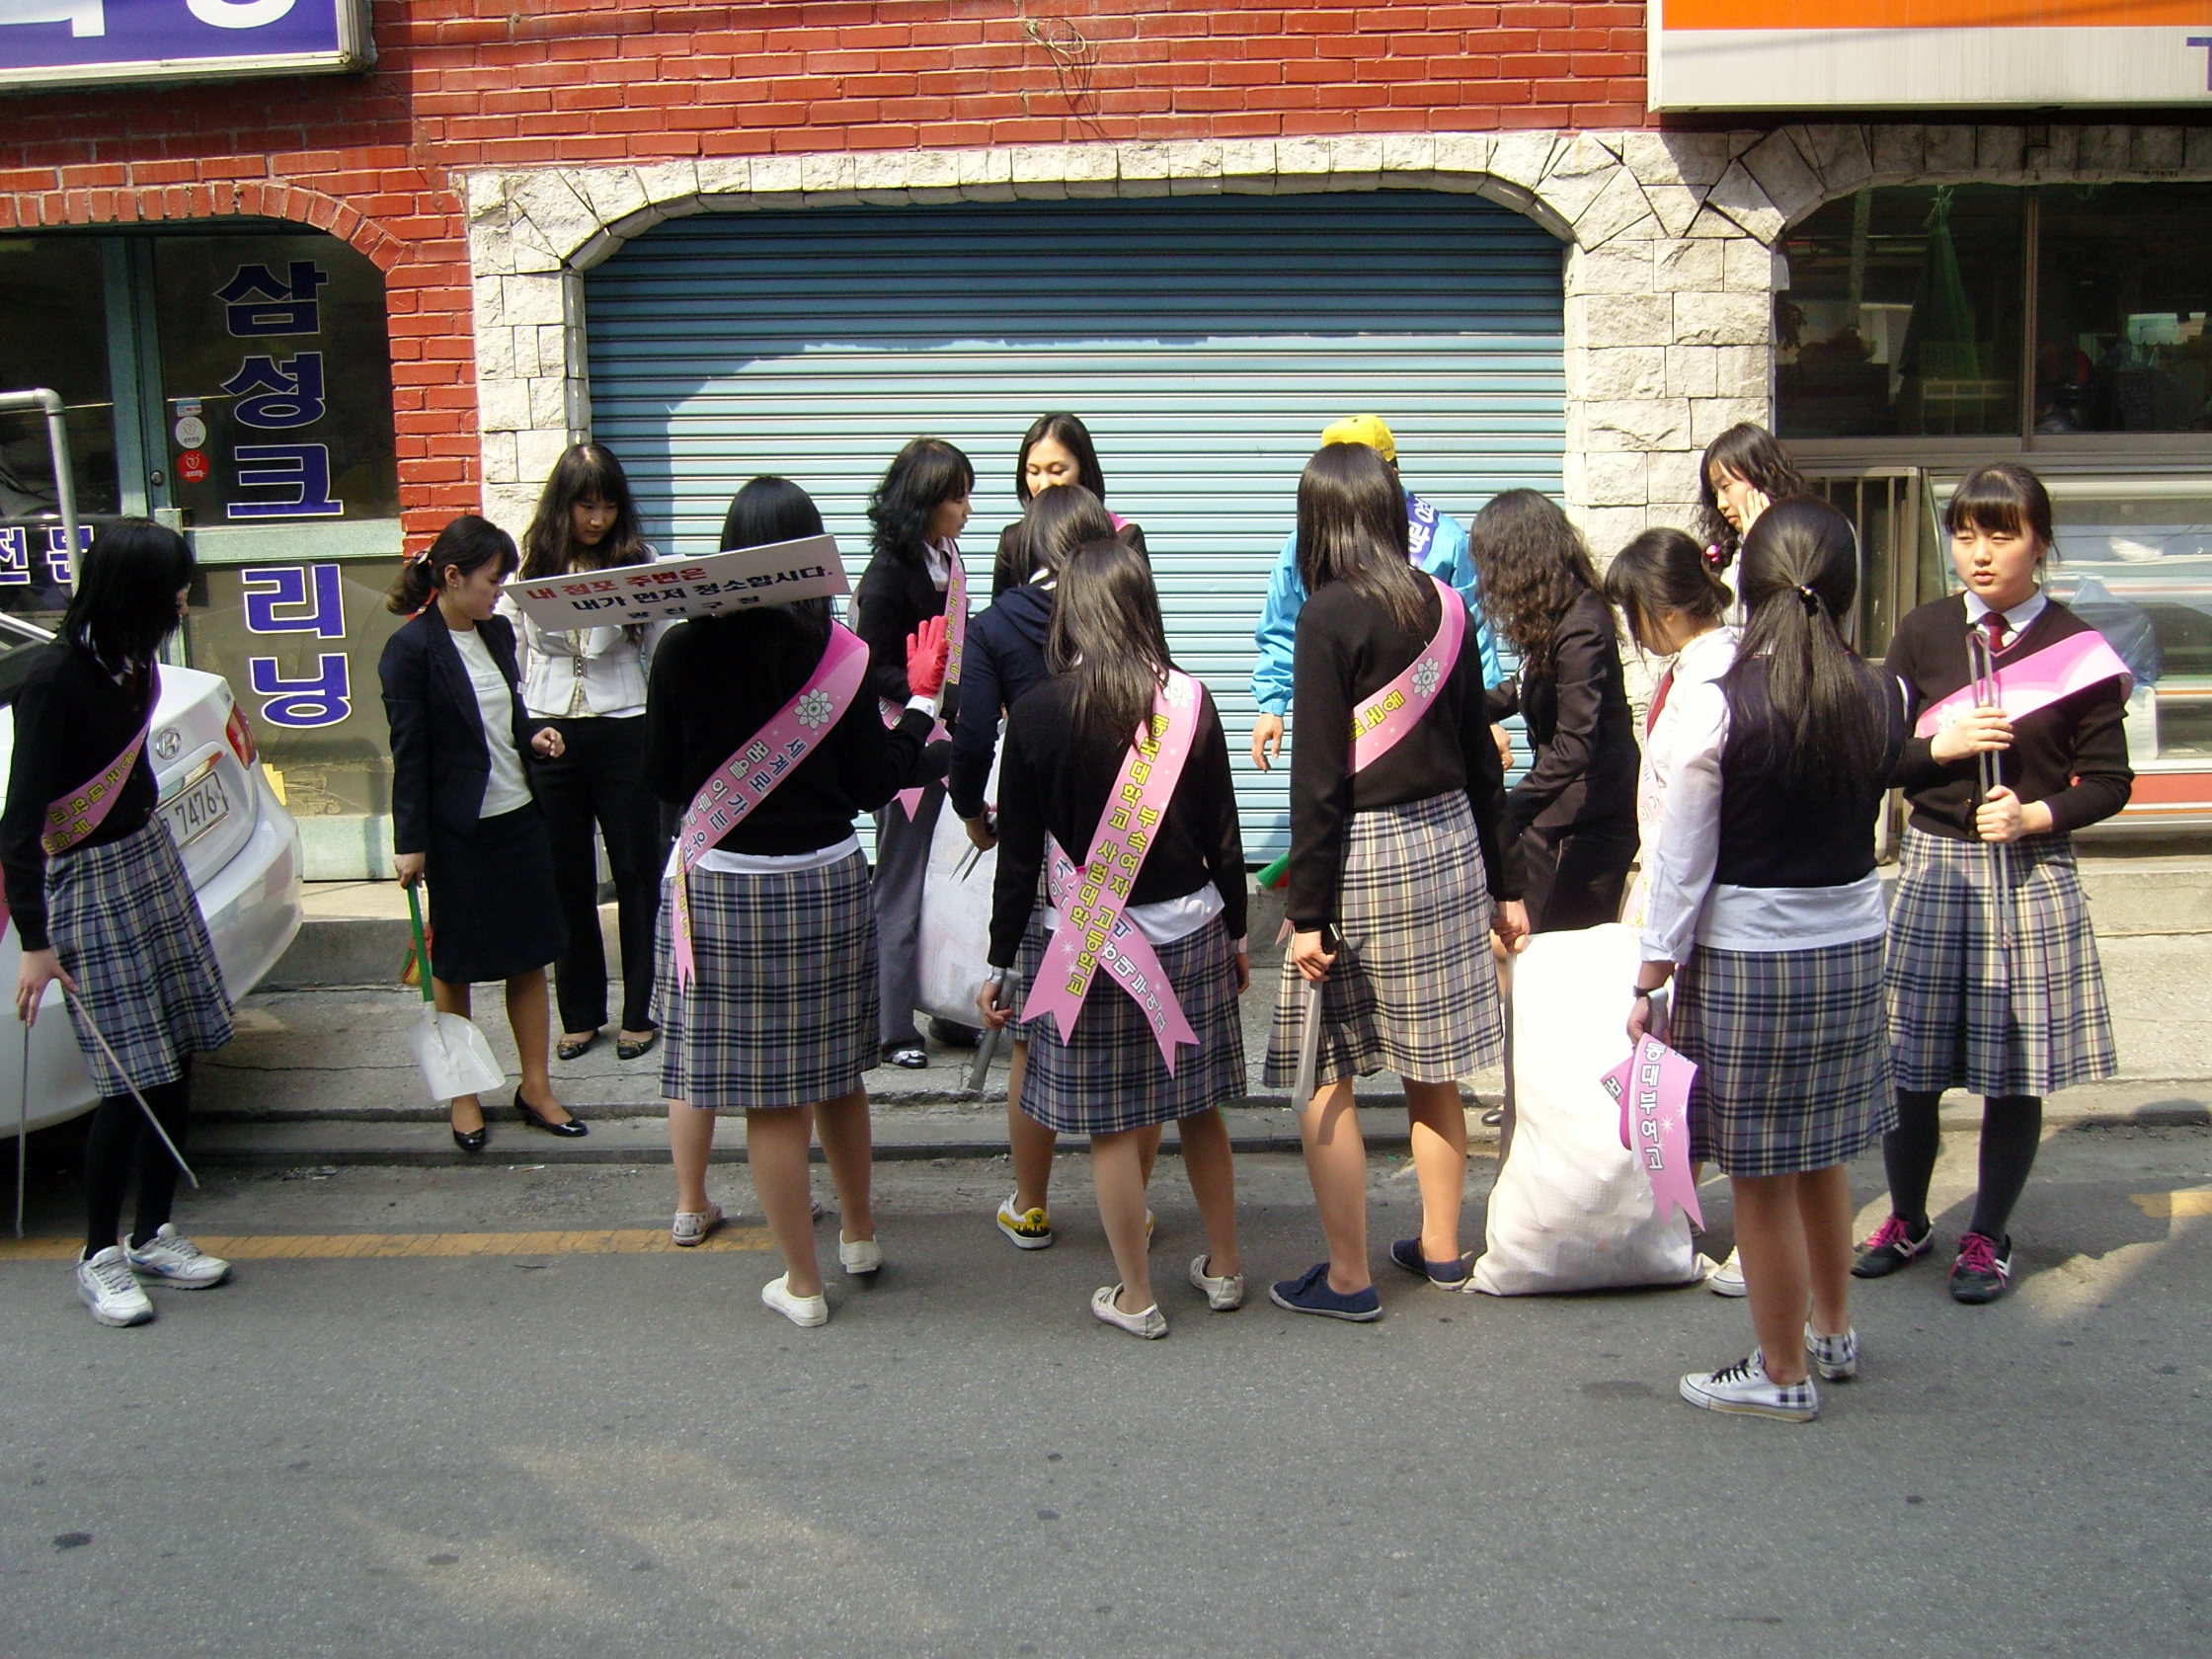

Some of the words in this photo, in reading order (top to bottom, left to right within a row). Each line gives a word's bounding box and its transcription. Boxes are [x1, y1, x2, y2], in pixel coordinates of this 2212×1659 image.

[525, 588, 557, 601] 내
[561, 581, 619, 596] 점포
[625, 566, 707, 589] 주변은
[571, 594, 626, 612] 내가
[632, 587, 687, 604] 먼저
[728, 740, 771, 779] 꿈을
[749, 736, 808, 794] 세계로
[175, 785, 217, 834] 7476
[710, 793, 750, 832] 가는
[1108, 804, 1157, 902] 부속여자
[1068, 838, 1118, 932] 사범대학
[1065, 905, 1117, 998] 고등학교
